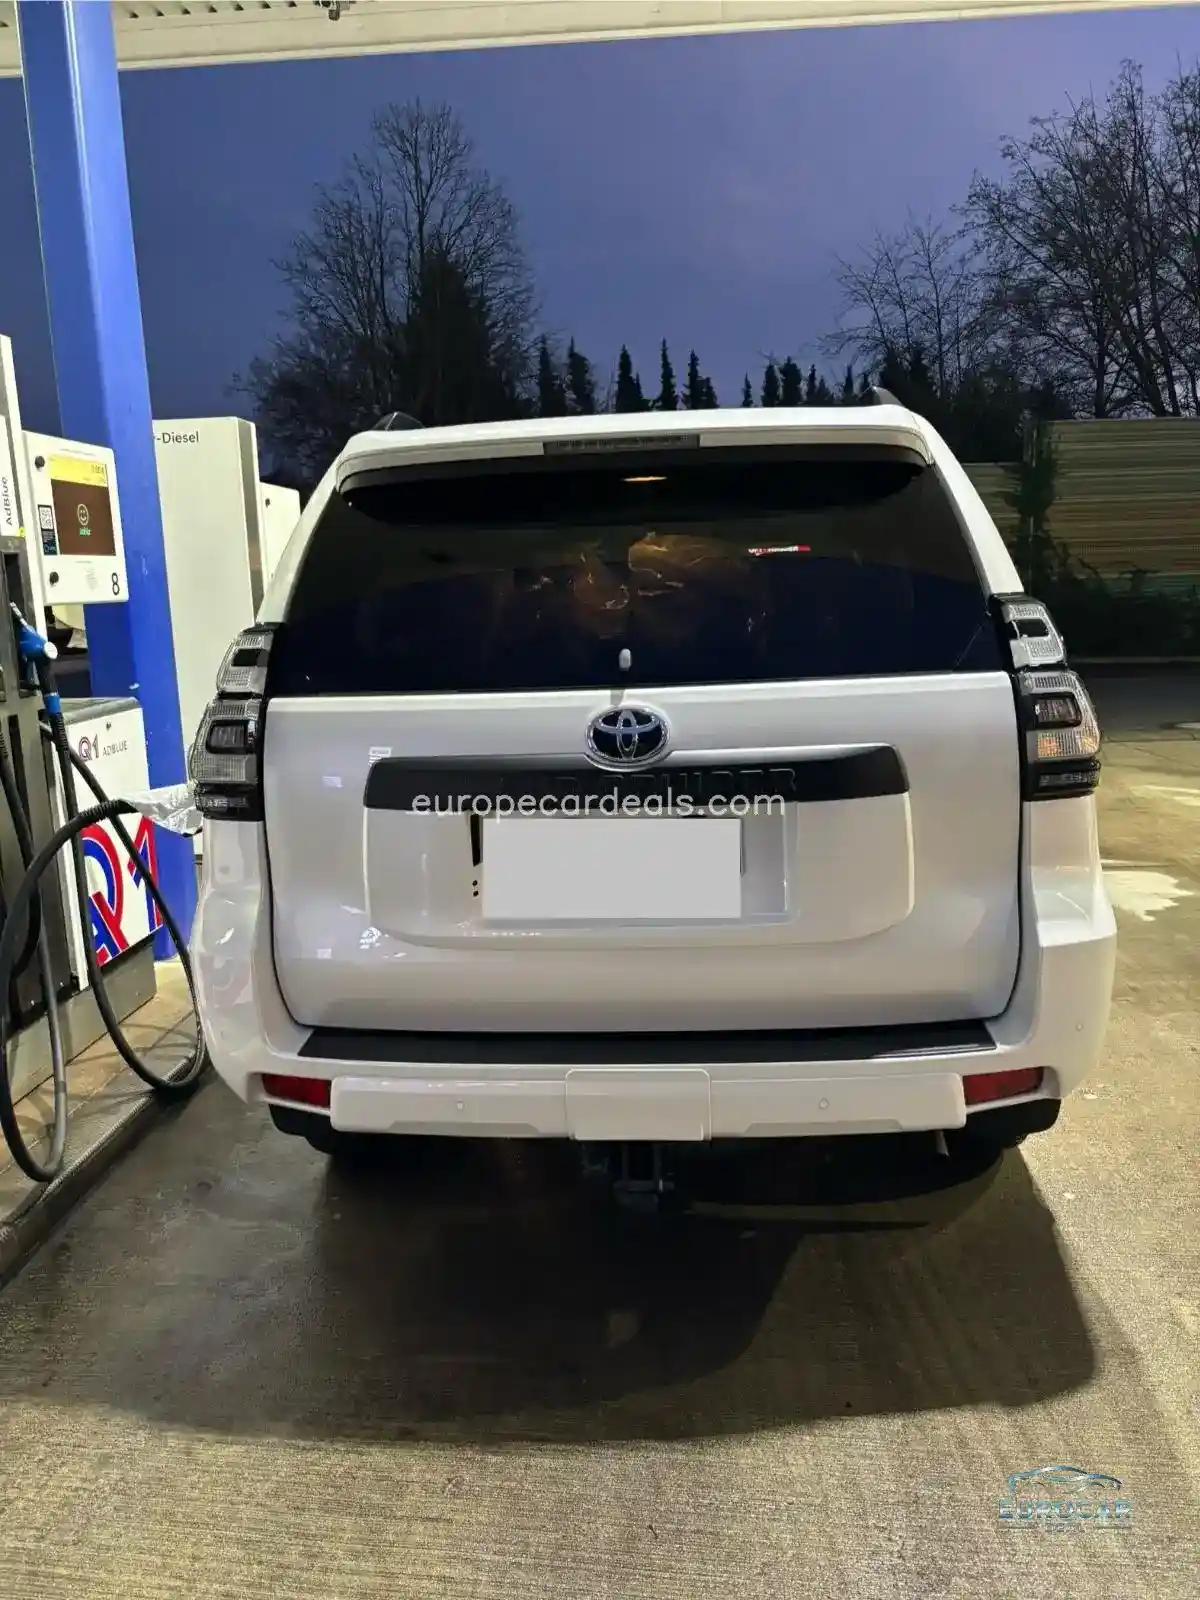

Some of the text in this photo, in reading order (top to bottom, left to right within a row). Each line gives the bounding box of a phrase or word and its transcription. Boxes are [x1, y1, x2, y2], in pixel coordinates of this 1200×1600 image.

[152, 430, 199, 444] -Diesel
[2, 477, 13, 525] AdBlue
[112, 572, 120, 596] 8
[78, 734, 128, 761] Q1 ADBLUE
